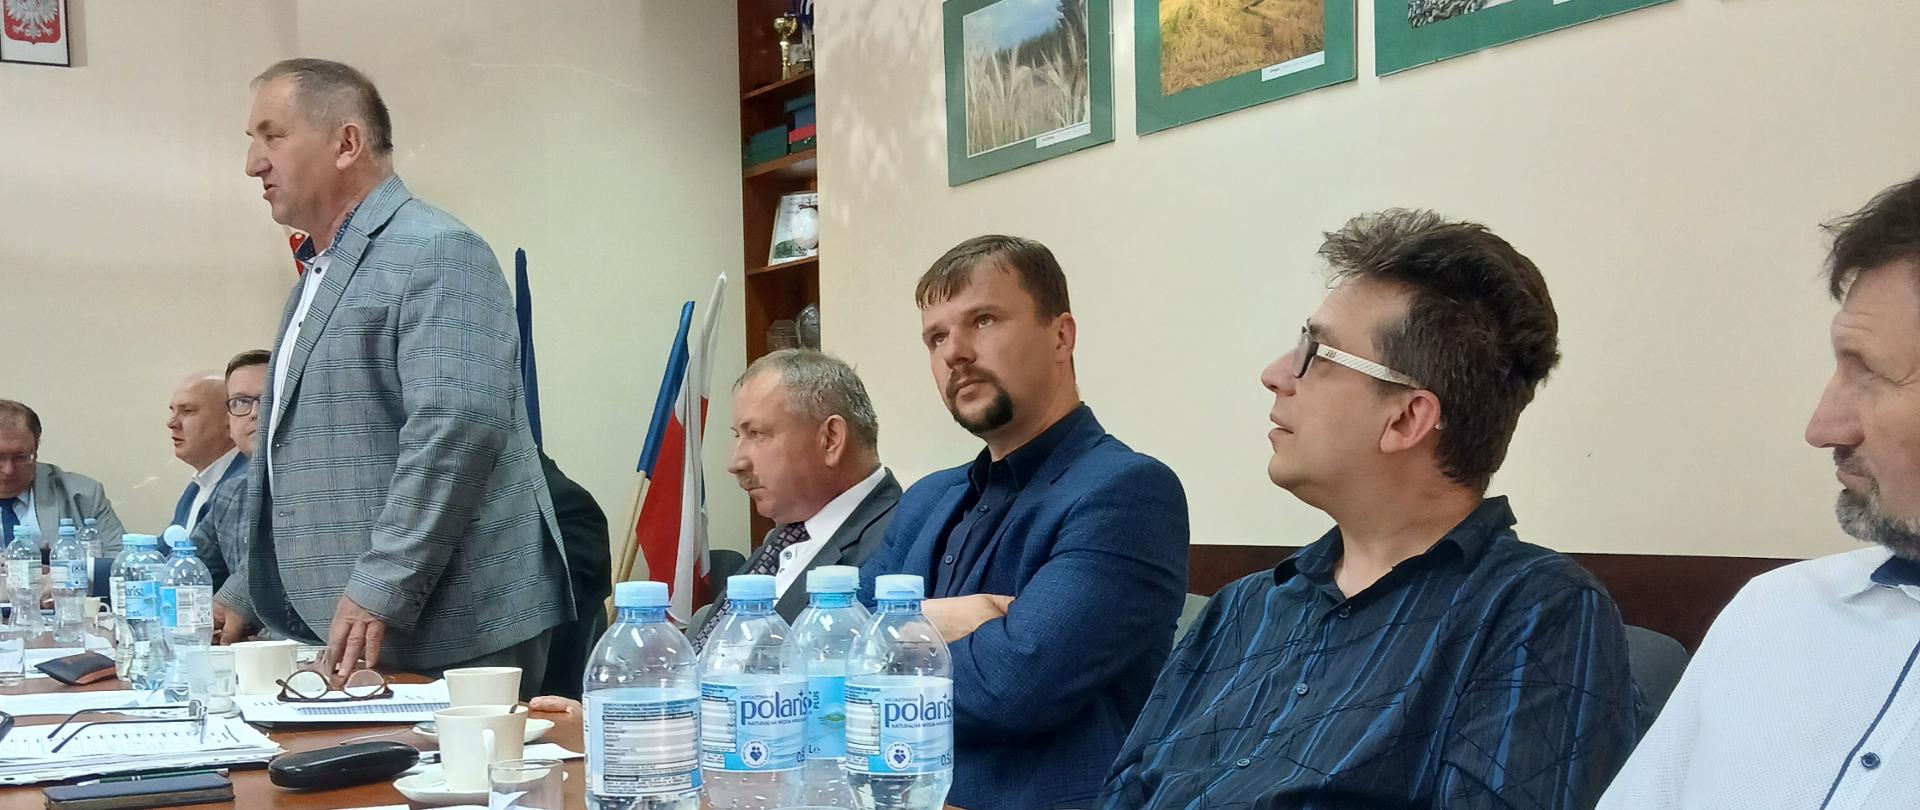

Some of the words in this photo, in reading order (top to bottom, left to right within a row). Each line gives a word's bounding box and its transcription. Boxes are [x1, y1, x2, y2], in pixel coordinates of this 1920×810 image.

[741, 690, 808, 726] polaris
[812, 691, 820, 709] PLUS
[884, 692, 952, 728] polaris
